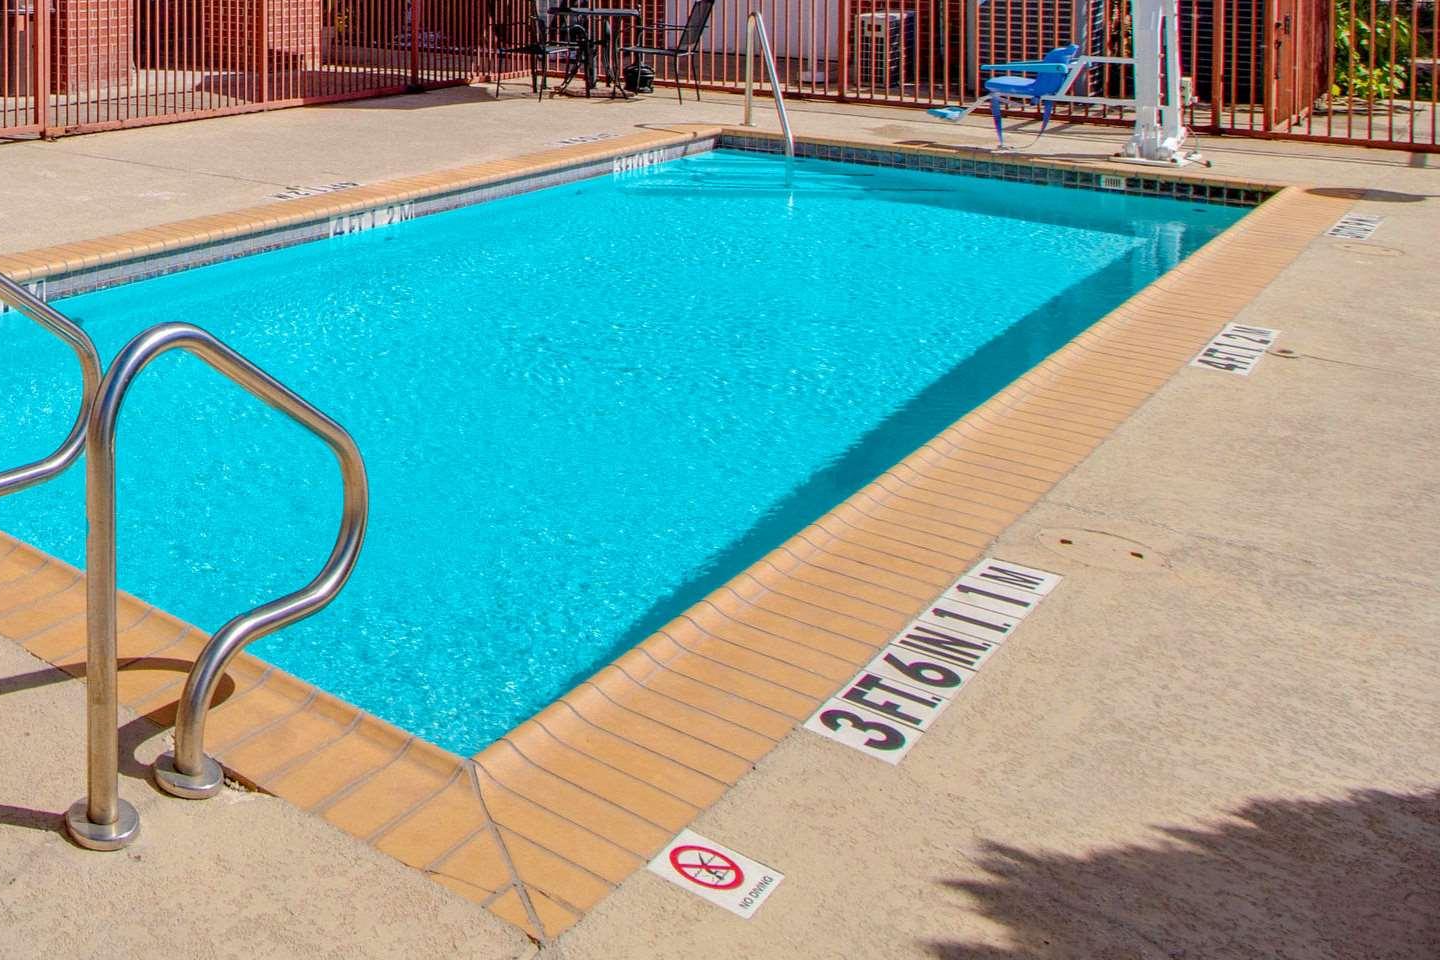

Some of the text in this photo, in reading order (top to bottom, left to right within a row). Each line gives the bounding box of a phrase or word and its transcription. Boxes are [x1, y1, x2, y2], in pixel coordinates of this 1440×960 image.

[819, 708, 906, 751] 3
[739, 875, 774, 910] NO DIVING
